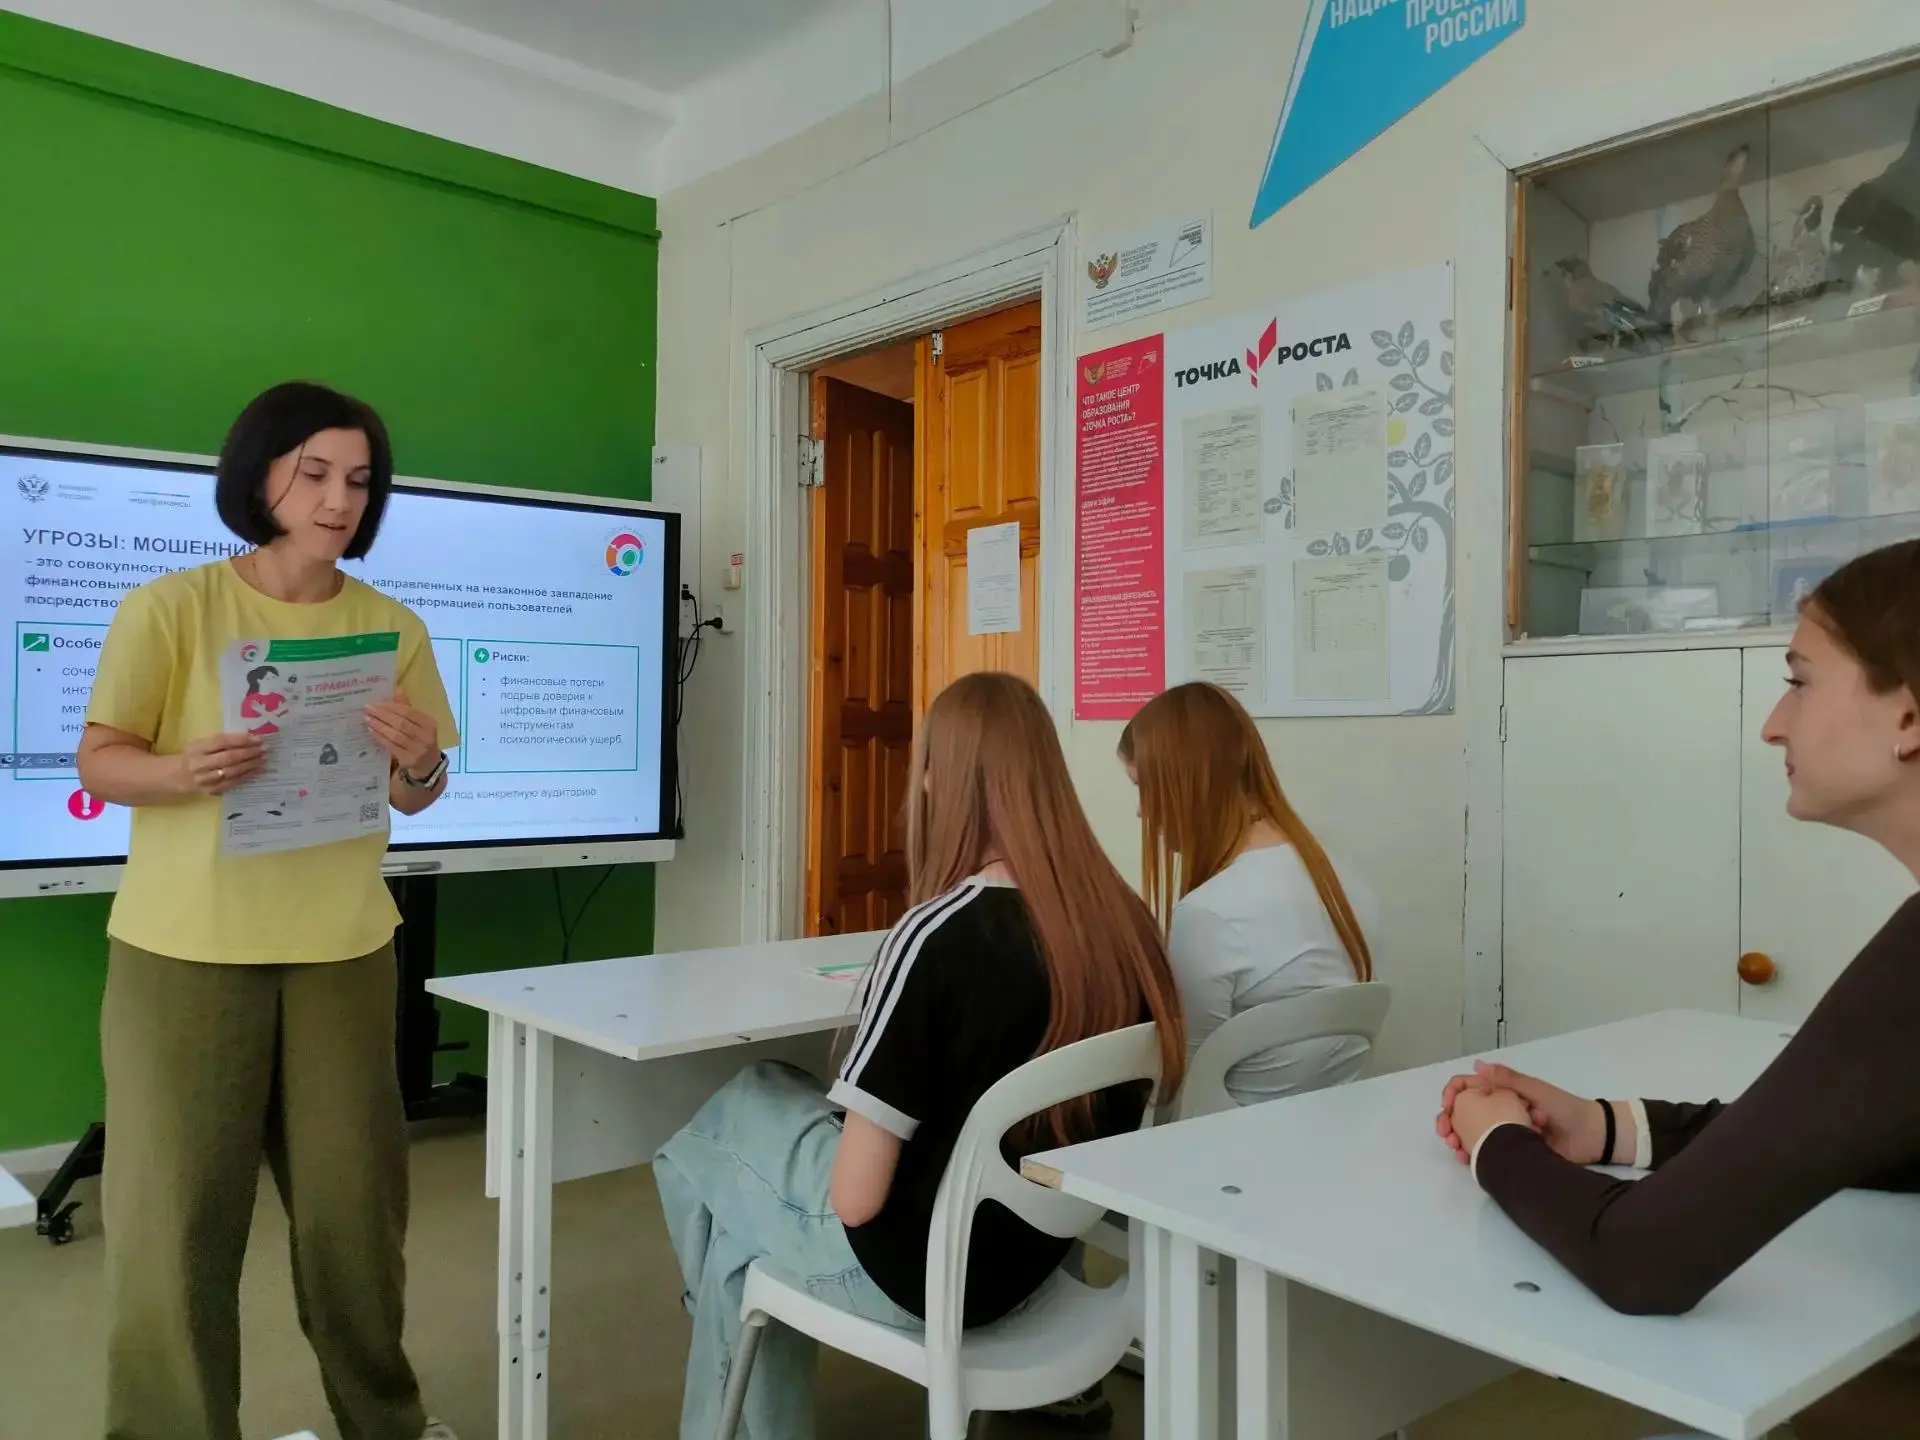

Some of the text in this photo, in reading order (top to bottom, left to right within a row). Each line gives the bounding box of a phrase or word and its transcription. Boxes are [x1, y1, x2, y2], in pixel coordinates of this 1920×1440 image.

[1330, 0, 1399, 28] НАЦ
[1406, 0, 1471, 29] ПРО
[1425, 0, 1518, 54] РОССИИ
[1174, 332, 1353, 388] ТОЧКА РОСТА
[1082, 383, 1140, 405] ЧТО ТАКОЕ ЦЕНТР
[1082, 399, 1130, 419] ОБРАЗОВАНИЯ
[23, 527, 125, 550] УГРОЗЫ:
[36, 557, 63, 568] это
[67, 559, 173, 574] совокупность
[26, 574, 141, 589] финансовыми
[372, 579, 462, 592] направленных
[465, 585, 479, 594] на
[483, 586, 547, 597] незаконное
[550, 590, 613, 601] завладение
[25, 595, 122, 609] посредство
[401, 596, 572, 614] информацией пользователей
[492, 651, 530, 662] Риски:
[500, 676, 605, 689] финансовые потери
[500, 692, 540, 702] подрыв
[542, 692, 585, 703] доверия
[500, 706, 624, 717] цифровым финансовым
[500, 722, 574, 731] инструментам
[499, 734, 623, 746] психологический ущерб
[454, 792, 474, 800] под
[476, 789, 538, 800] конкретную
[541, 787, 597, 799] аудиторию
